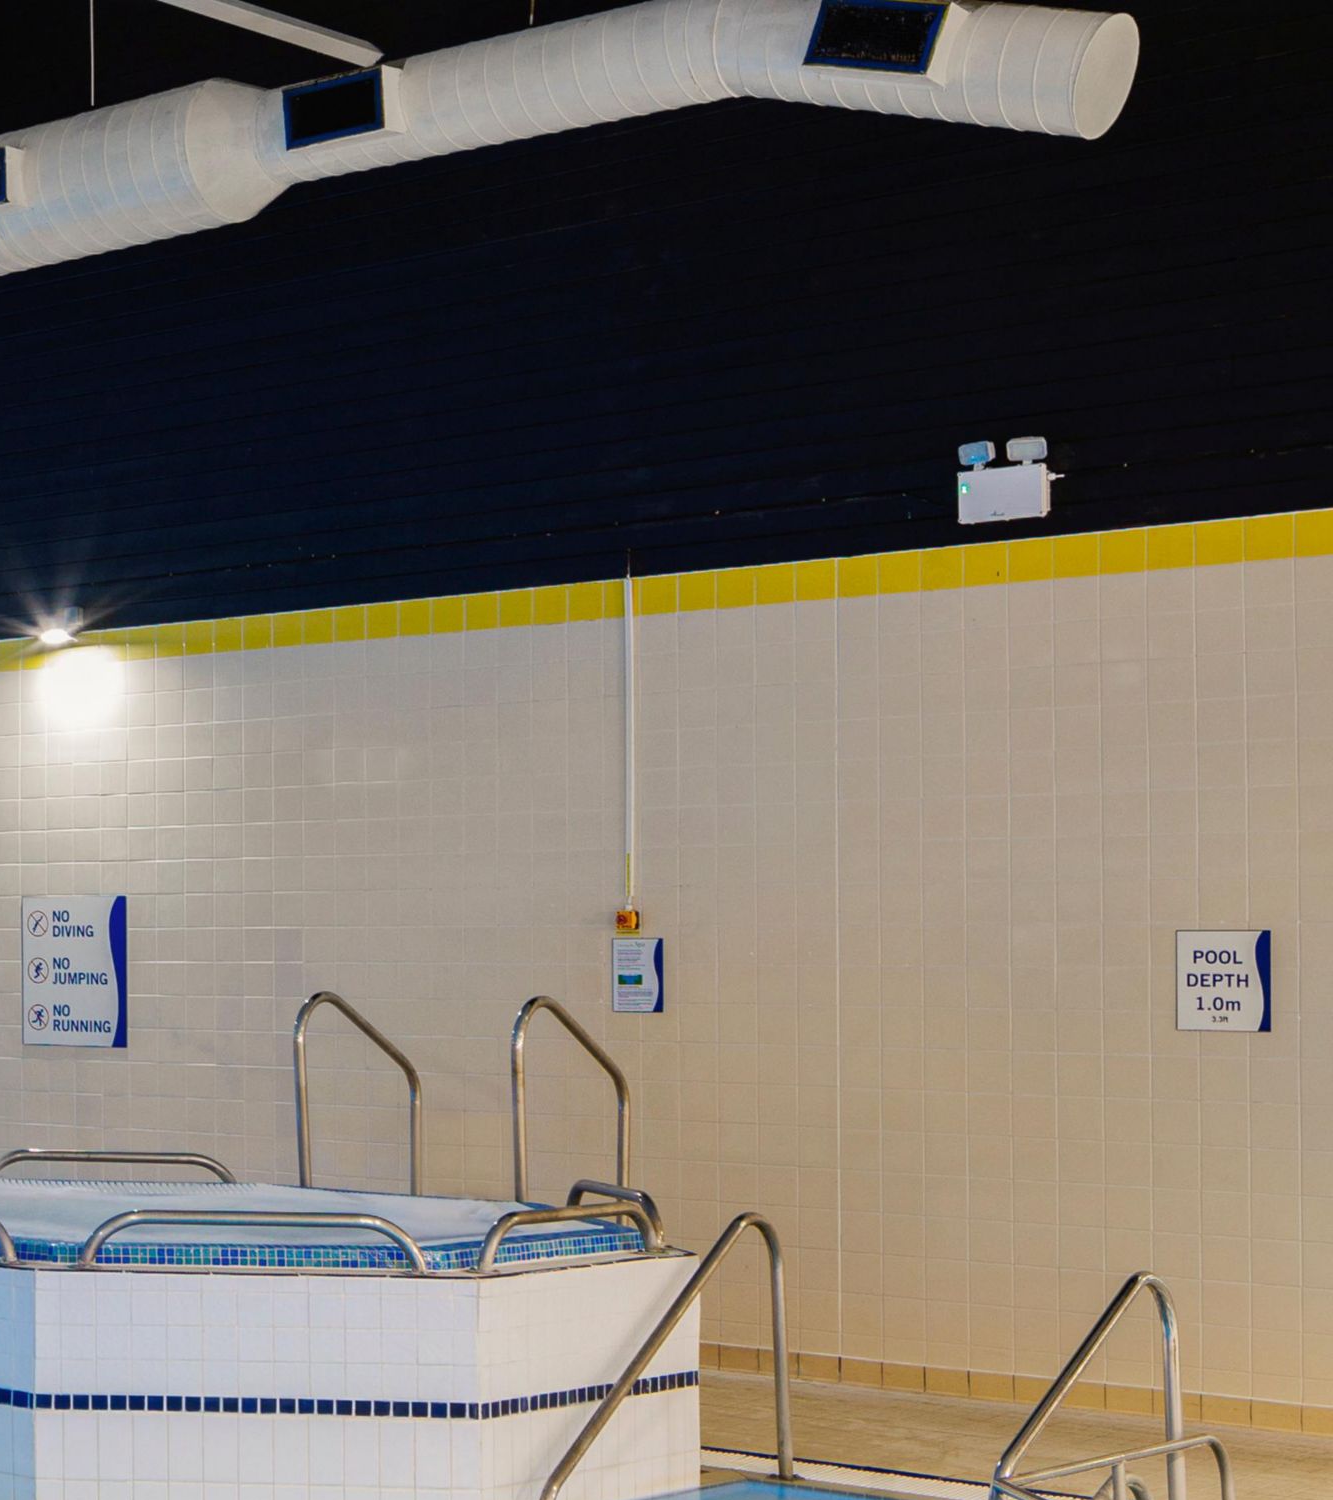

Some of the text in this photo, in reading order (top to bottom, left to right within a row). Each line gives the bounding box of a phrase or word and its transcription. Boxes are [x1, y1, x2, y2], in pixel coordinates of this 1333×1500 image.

[52, 910, 70, 923] NO
[52, 925, 94, 938] DIVING
[52, 957, 71, 970] NO
[1193, 950, 1243, 965] POOL
[52, 972, 108, 985] JUMPING
[1186, 973, 1249, 988] DEPTH
[1196, 996, 1241, 1011] 1.0m
[53, 1004, 71, 1017] NO
[53, 1019, 111, 1033] RUNNING
